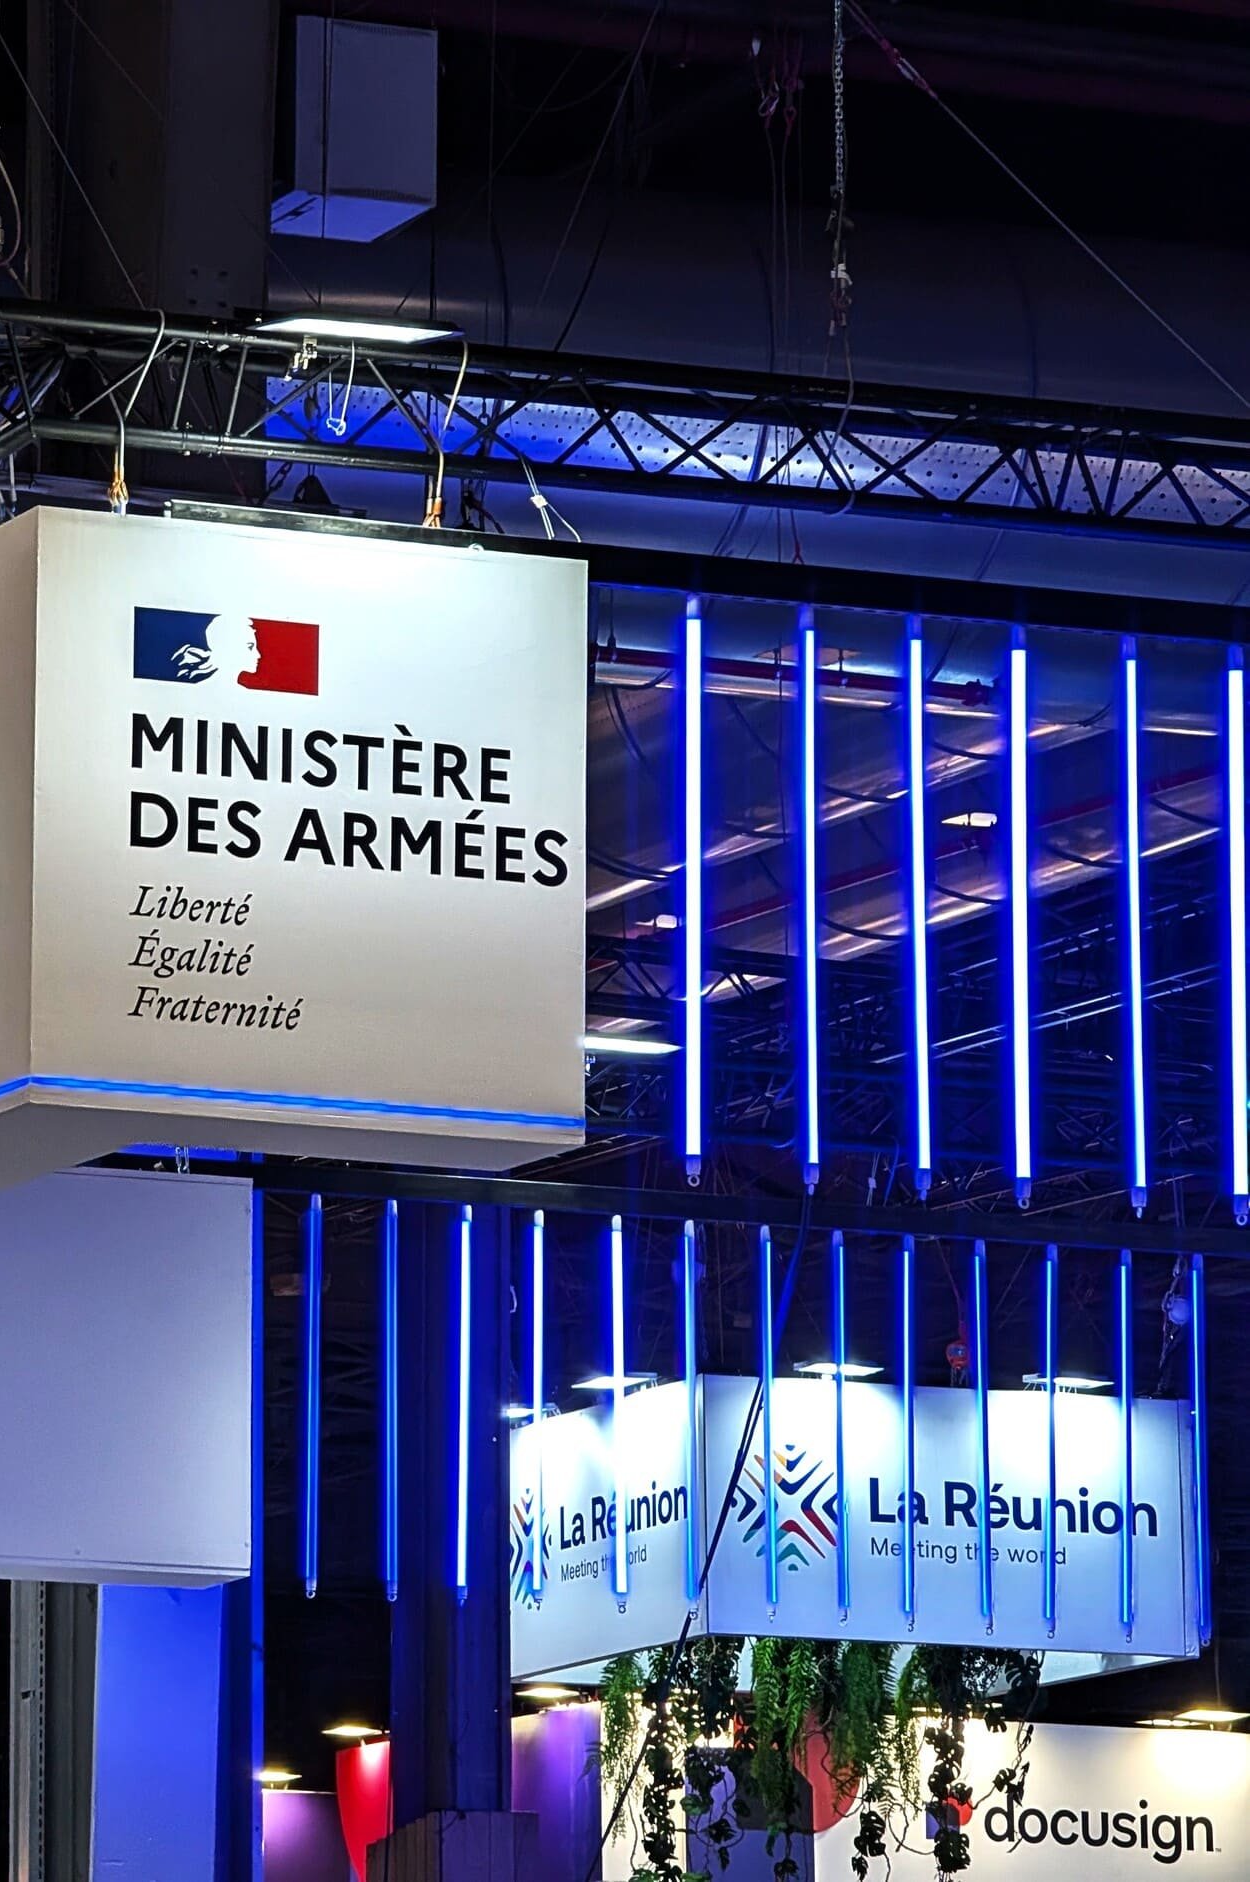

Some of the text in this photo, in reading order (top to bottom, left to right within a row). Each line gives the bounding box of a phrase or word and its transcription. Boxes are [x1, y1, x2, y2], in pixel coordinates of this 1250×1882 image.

[130, 712, 511, 804] MINISTÈRE
[129, 790, 569, 887] DES ARMÉES
[129, 885, 253, 926] Liberté
[127, 930, 255, 978] Égalité
[127, 986, 304, 1030] Fraternité
[560, 1506, 586, 1550] La
[869, 1477, 1158, 1537] La Réunion
[560, 1559, 599, 1582] Meeting
[870, 1537, 958, 1564] Meting
[984, 1795, 1214, 1864] docusign
